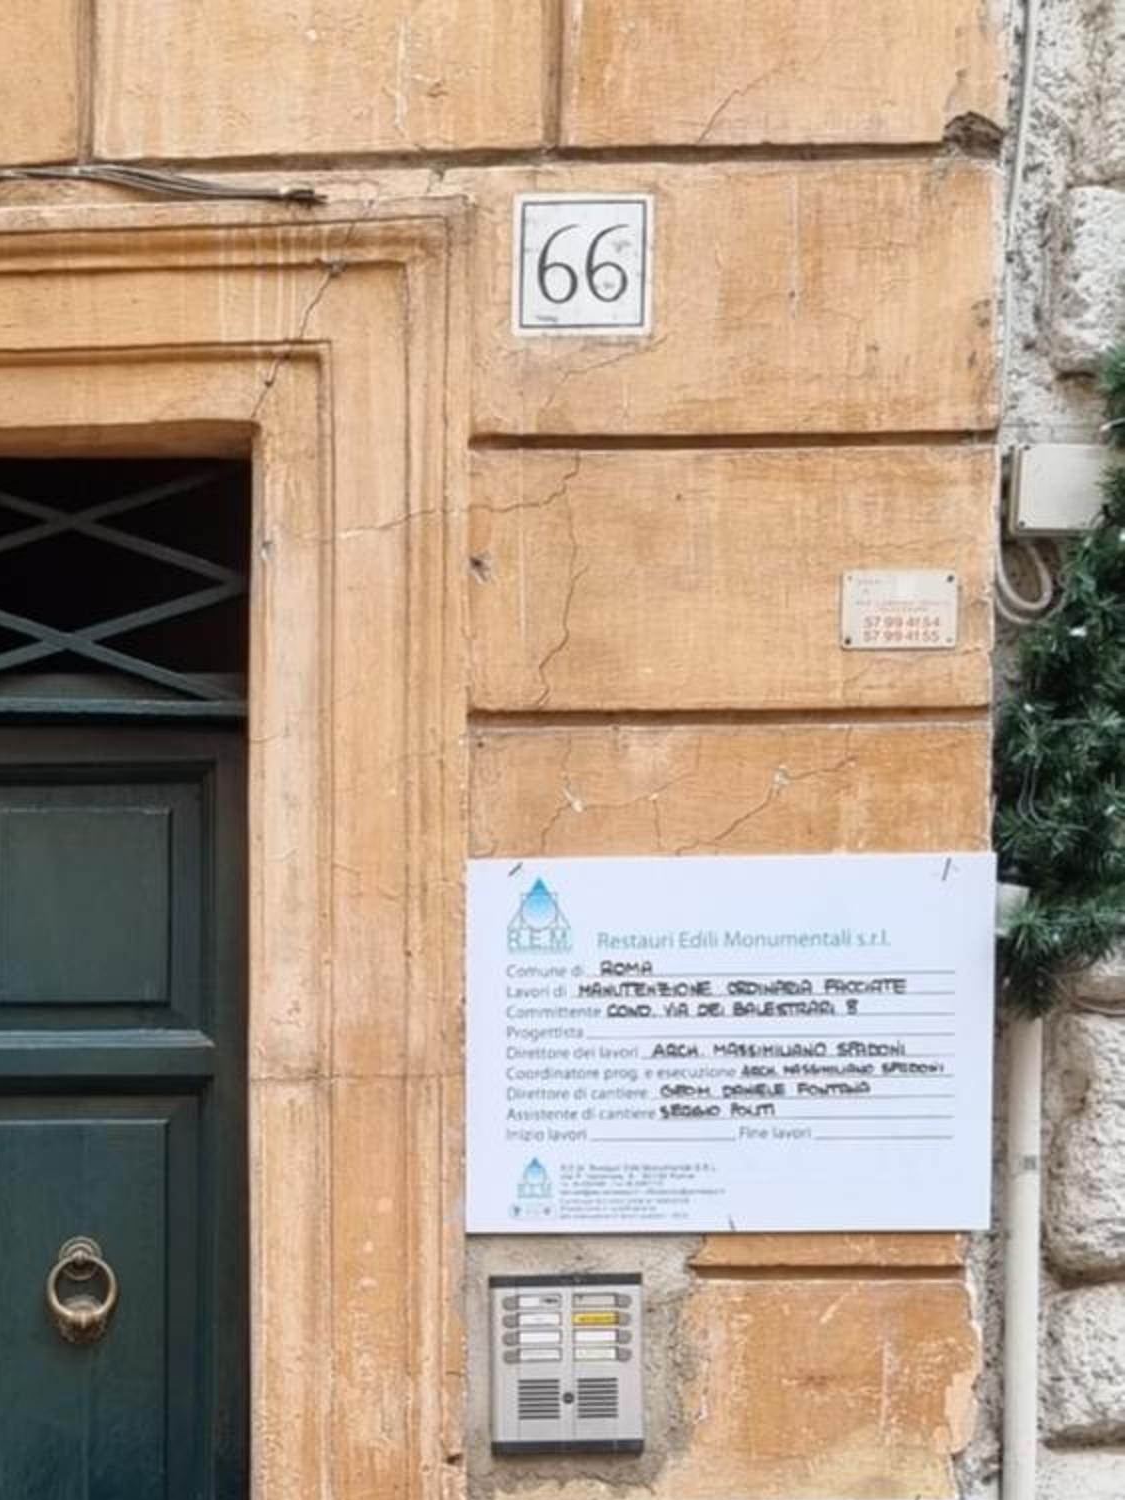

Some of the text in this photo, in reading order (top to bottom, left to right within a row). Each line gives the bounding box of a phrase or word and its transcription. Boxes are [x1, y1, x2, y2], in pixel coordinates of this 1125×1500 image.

[537, 224, 629, 304] 66
[596, 928, 892, 949] Restauri Edili Monumentali s.r.l.
[506, 963, 583, 978] Comune di
[599, 959, 654, 977] ROMA
[506, 983, 567, 998] Lavori di
[577, 977, 908, 997] MANUTENZIONE ORDINARIA FACCIATE
[506, 1003, 602, 1019] Committente
[664, 1001, 690, 1018] VIA
[696, 1002, 725, 1018] DEI
[732, 1000, 835, 1018] BALESTRARI
[506, 1024, 585, 1042] Progettista
[506, 1045, 571, 1060] Direttore
[599, 1045, 639, 1059] lavori
[713, 1041, 827, 1058] MASSIMILIANO
[836, 1038, 907, 1058] SPADONI
[506, 1065, 599, 1081] Coordinatore
[645, 1069, 653, 1079] e
[657, 1065, 736, 1080] esecuzione
[506, 1085, 648, 1101] Direttore di cantiere
[721, 1082, 786, 1099] DANIELE
[507, 1106, 656, 1121] Assistente di cantiere
[506, 1125, 812, 1143] Inizio lavori Fine lavori
